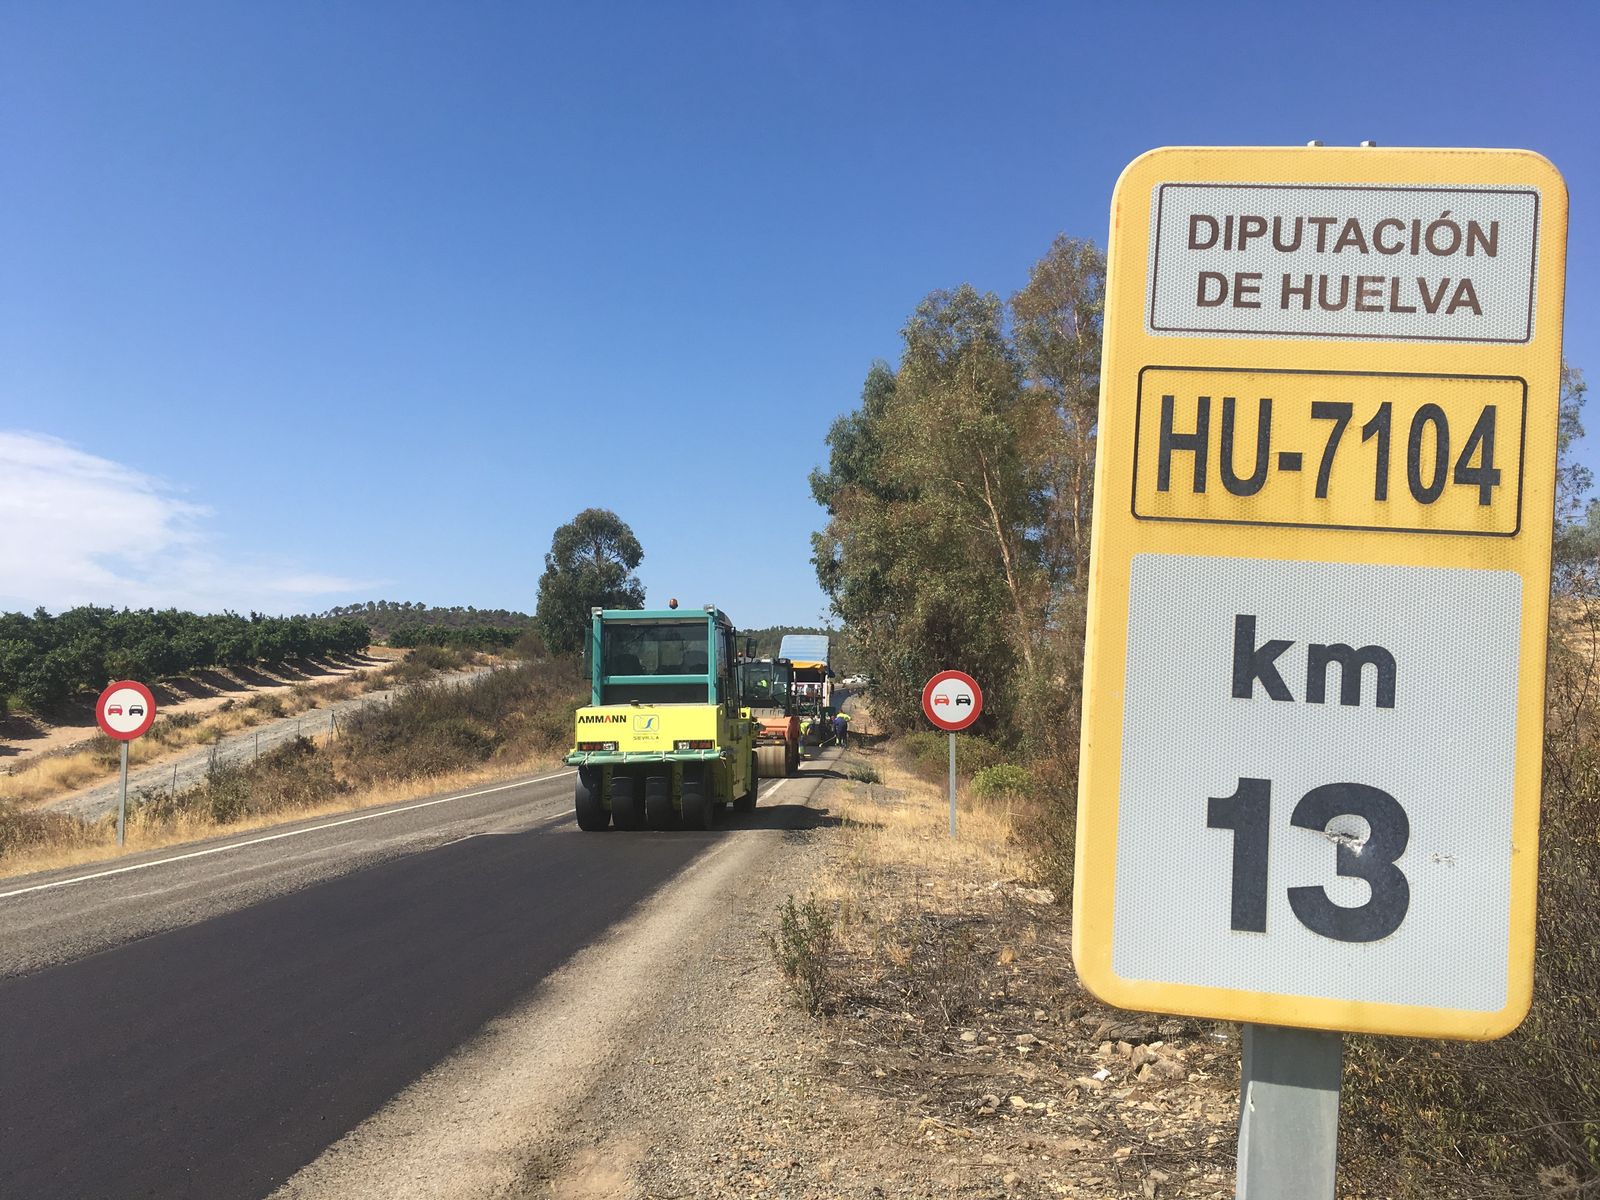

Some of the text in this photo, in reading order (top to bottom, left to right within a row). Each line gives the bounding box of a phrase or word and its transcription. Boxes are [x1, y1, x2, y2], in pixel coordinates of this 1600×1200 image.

[1188, 211, 1499, 258] DIPUTACIÓN
[1195, 271, 1483, 315] DE HUELVA
[1156, 394, 1500, 506] HU-7104
[1231, 614, 1397, 709] km
[577, 714, 627, 724] AMMANN
[1206, 777, 1411, 943] 13
